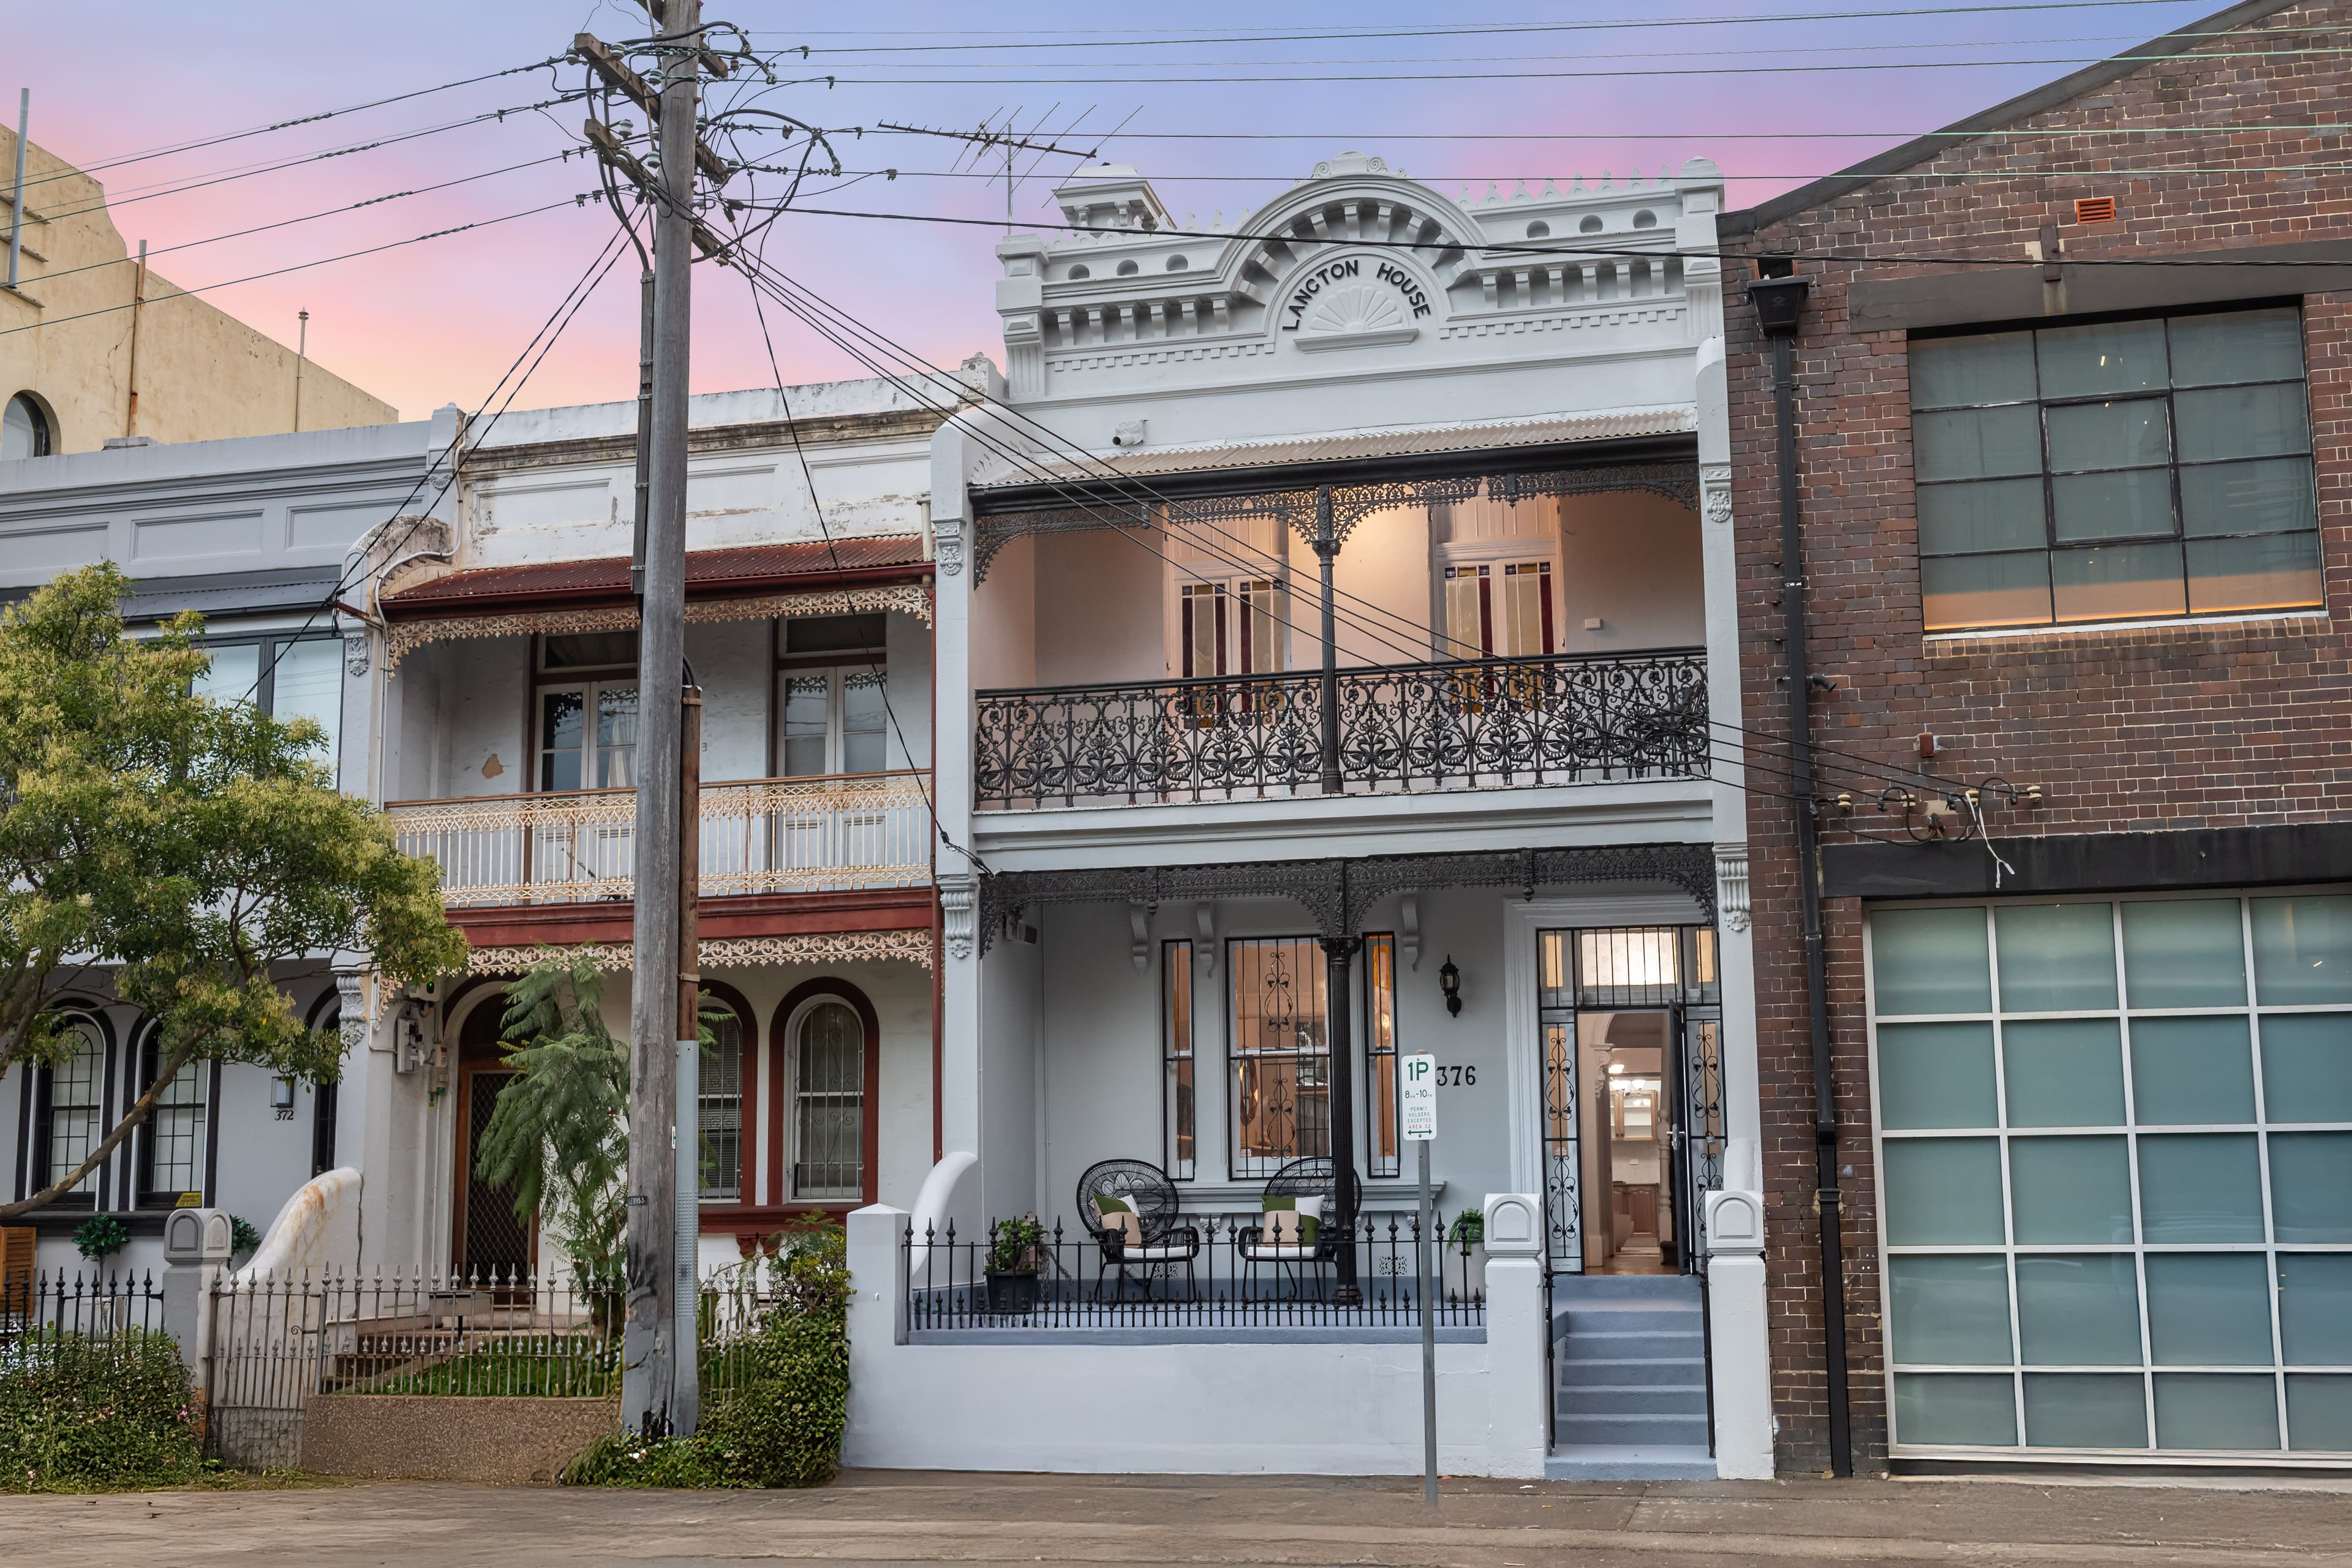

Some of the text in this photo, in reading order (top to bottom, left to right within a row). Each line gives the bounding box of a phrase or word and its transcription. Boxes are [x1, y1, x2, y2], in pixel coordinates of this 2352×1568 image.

[1282, 259, 1431, 331] LANGTON HOUSE
[1408, 1061, 1429, 1081] 1P
[1436, 1066, 1476, 1086] 376
[274, 1109, 294, 1121] 372
